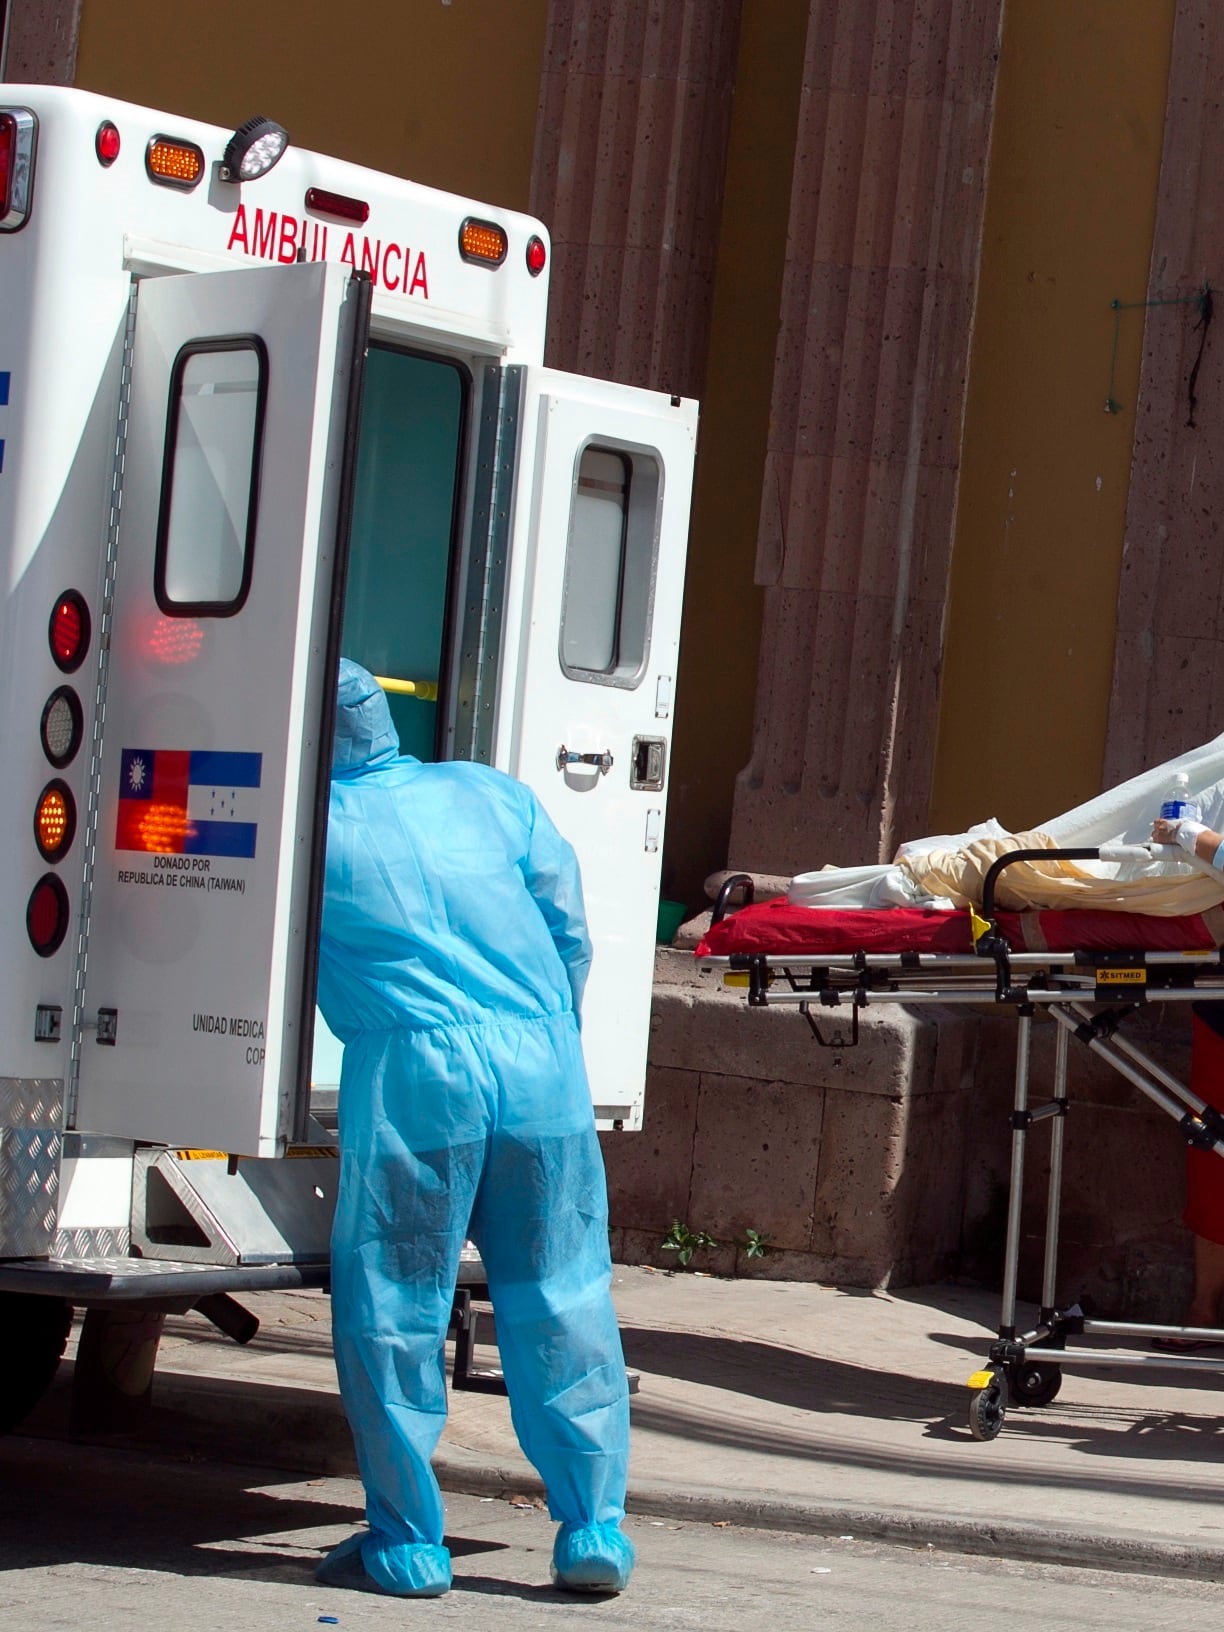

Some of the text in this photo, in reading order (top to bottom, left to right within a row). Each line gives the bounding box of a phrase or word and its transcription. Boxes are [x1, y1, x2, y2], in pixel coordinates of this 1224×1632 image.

[154, 856, 210, 872] DONADO POR
[118, 870, 246, 894] REPUBLICA DE CHINA (TAIWAN)
[193, 1014, 264, 1039] UNIDAD MEDICA
